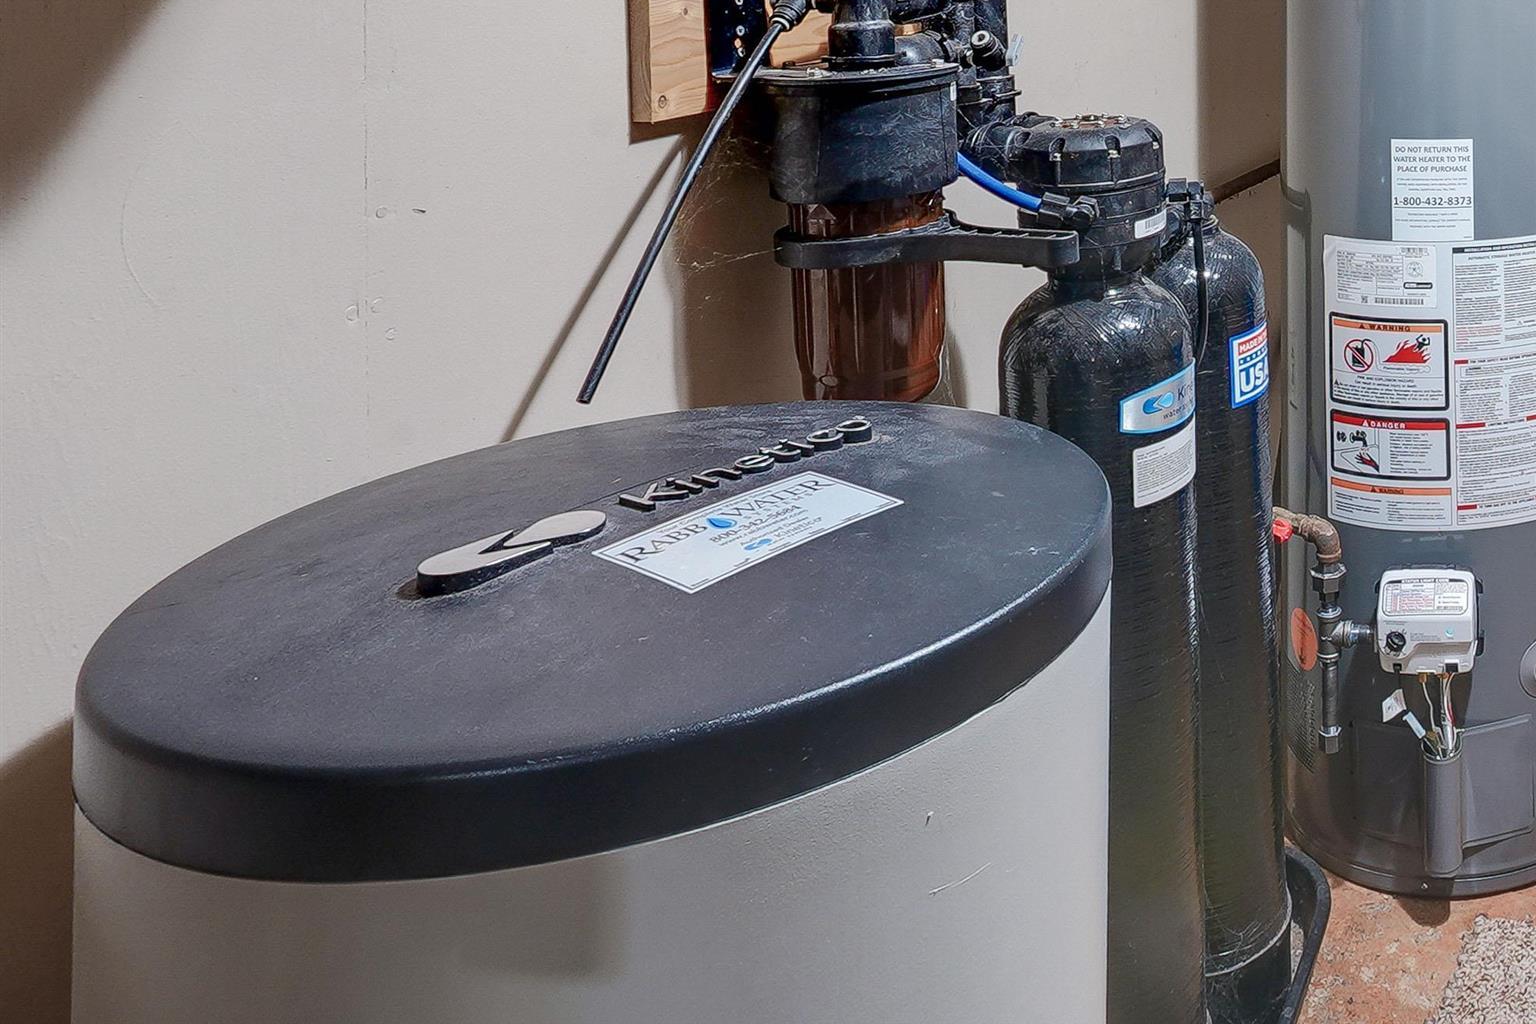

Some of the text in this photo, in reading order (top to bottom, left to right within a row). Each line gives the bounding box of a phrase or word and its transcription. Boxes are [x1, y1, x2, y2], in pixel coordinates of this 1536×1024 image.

[1393, 155, 1471, 163] WATER HEATER TO THE
[1397, 165, 1467, 173] PLACE OF PURCHASE
[1393, 196, 1472, 206] 1-800-432-8373
[1370, 324, 1411, 332] WARNING
[1370, 420, 1406, 430] DANGER
[619, 416, 872, 512] Kinetico
[620, 478, 837, 563] RABB WATER
